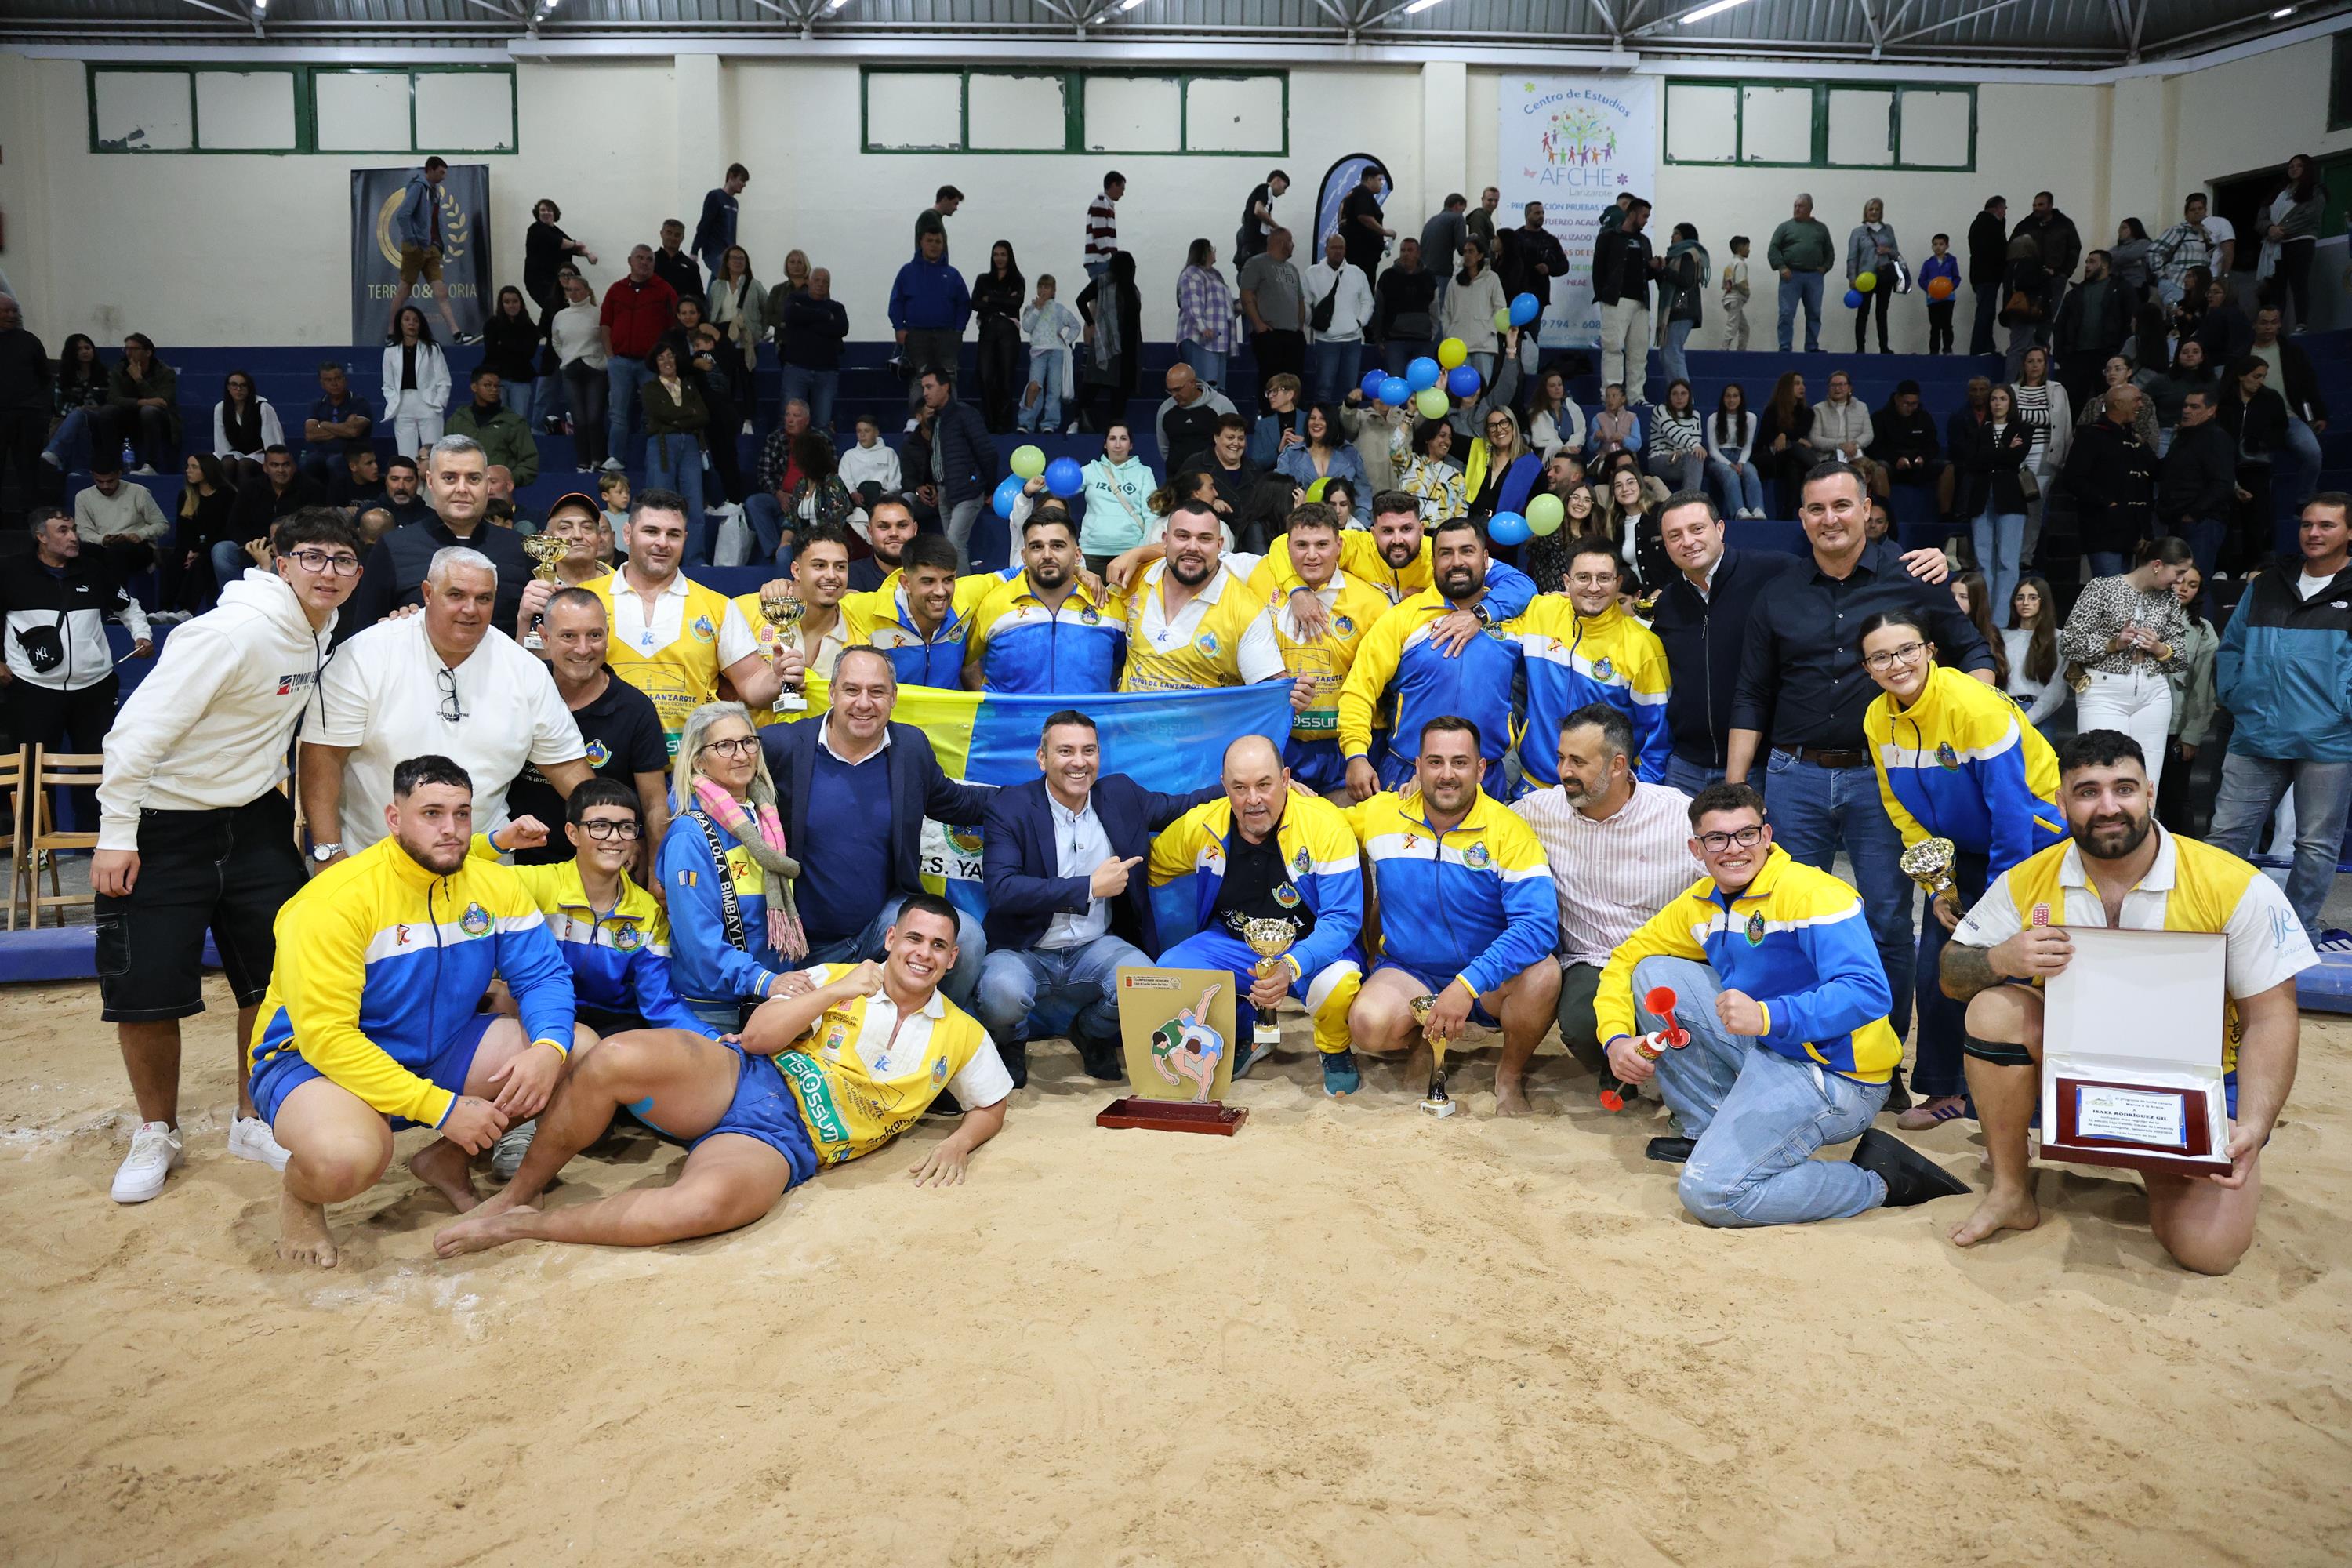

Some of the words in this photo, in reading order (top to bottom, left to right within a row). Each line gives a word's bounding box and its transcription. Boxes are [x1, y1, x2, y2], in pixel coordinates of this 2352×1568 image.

[1524, 93, 1563, 115] Centro
[1566, 89, 1581, 99] de
[1584, 89, 1631, 118] Estudios
[1539, 167, 1613, 187] AFCHE
[1569, 187, 1613, 197] Lanzarote
[1313, 674, 1343, 683] ZAROTE
[649, 693, 697, 703] LANZAROTE
[956, 859, 983, 880] YA
[828, 1013, 857, 1027] Lanzarote
